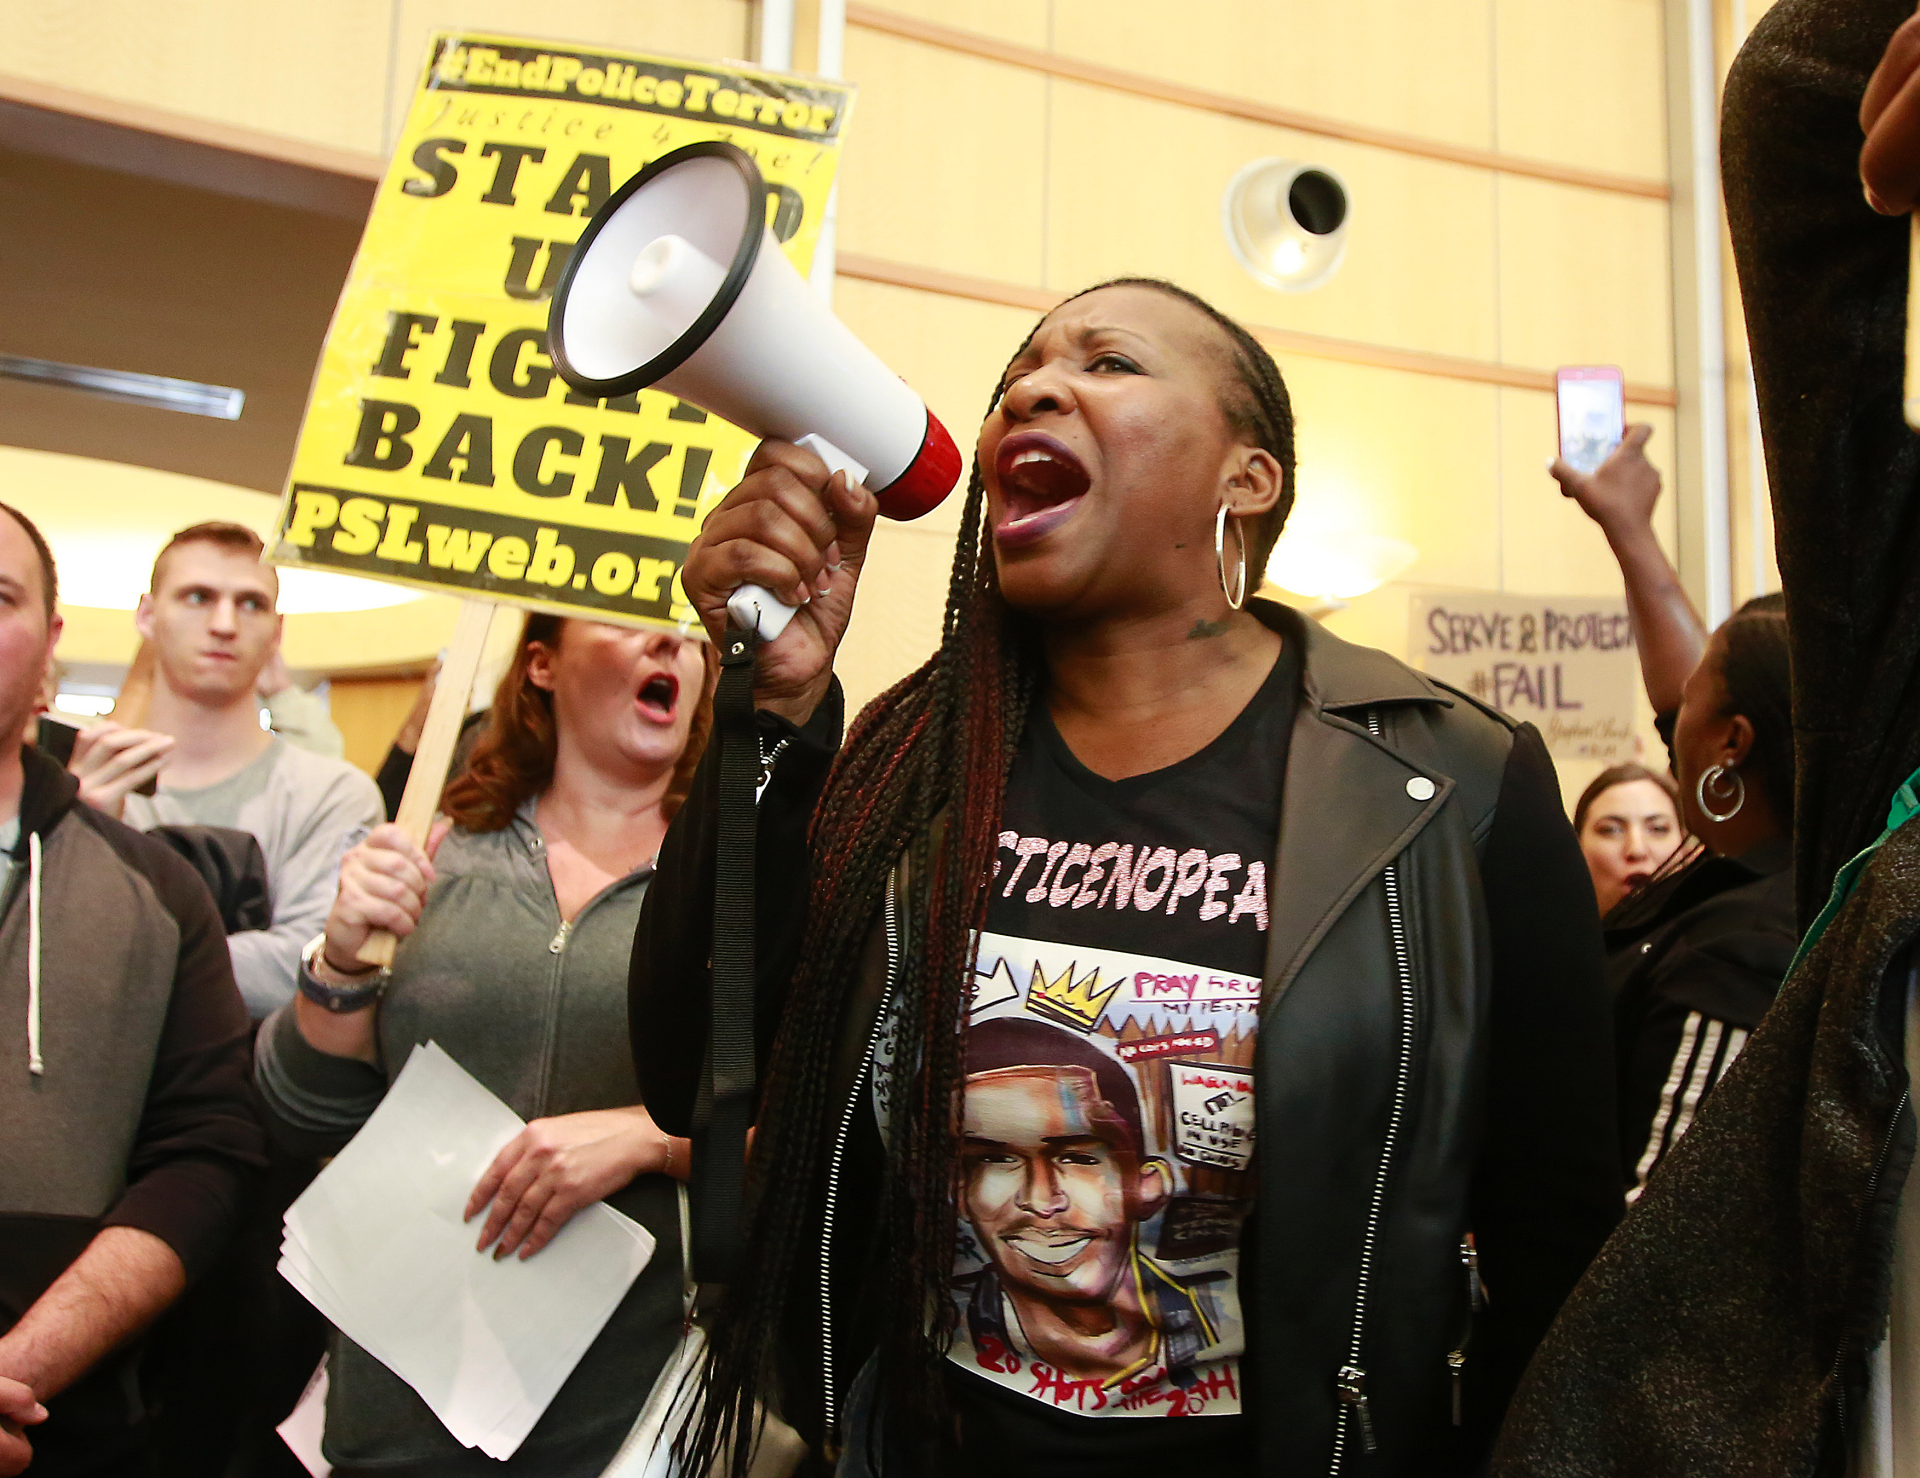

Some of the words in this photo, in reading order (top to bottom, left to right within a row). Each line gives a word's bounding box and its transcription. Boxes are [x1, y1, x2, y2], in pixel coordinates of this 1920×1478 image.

[427, 97, 614, 139] Justice
[651, 122, 671, 146] 4
[437, 44, 836, 134] #EndPoliceTerror
[371, 311, 709, 424] FIG
[344, 398, 713, 519] BACK!
[1427, 606, 1514, 655] SERVE
[1134, 971, 1199, 1000] PRAY
[976, 1336, 1022, 1375] 20
[1028, 1361, 1108, 1411] SHOTS
